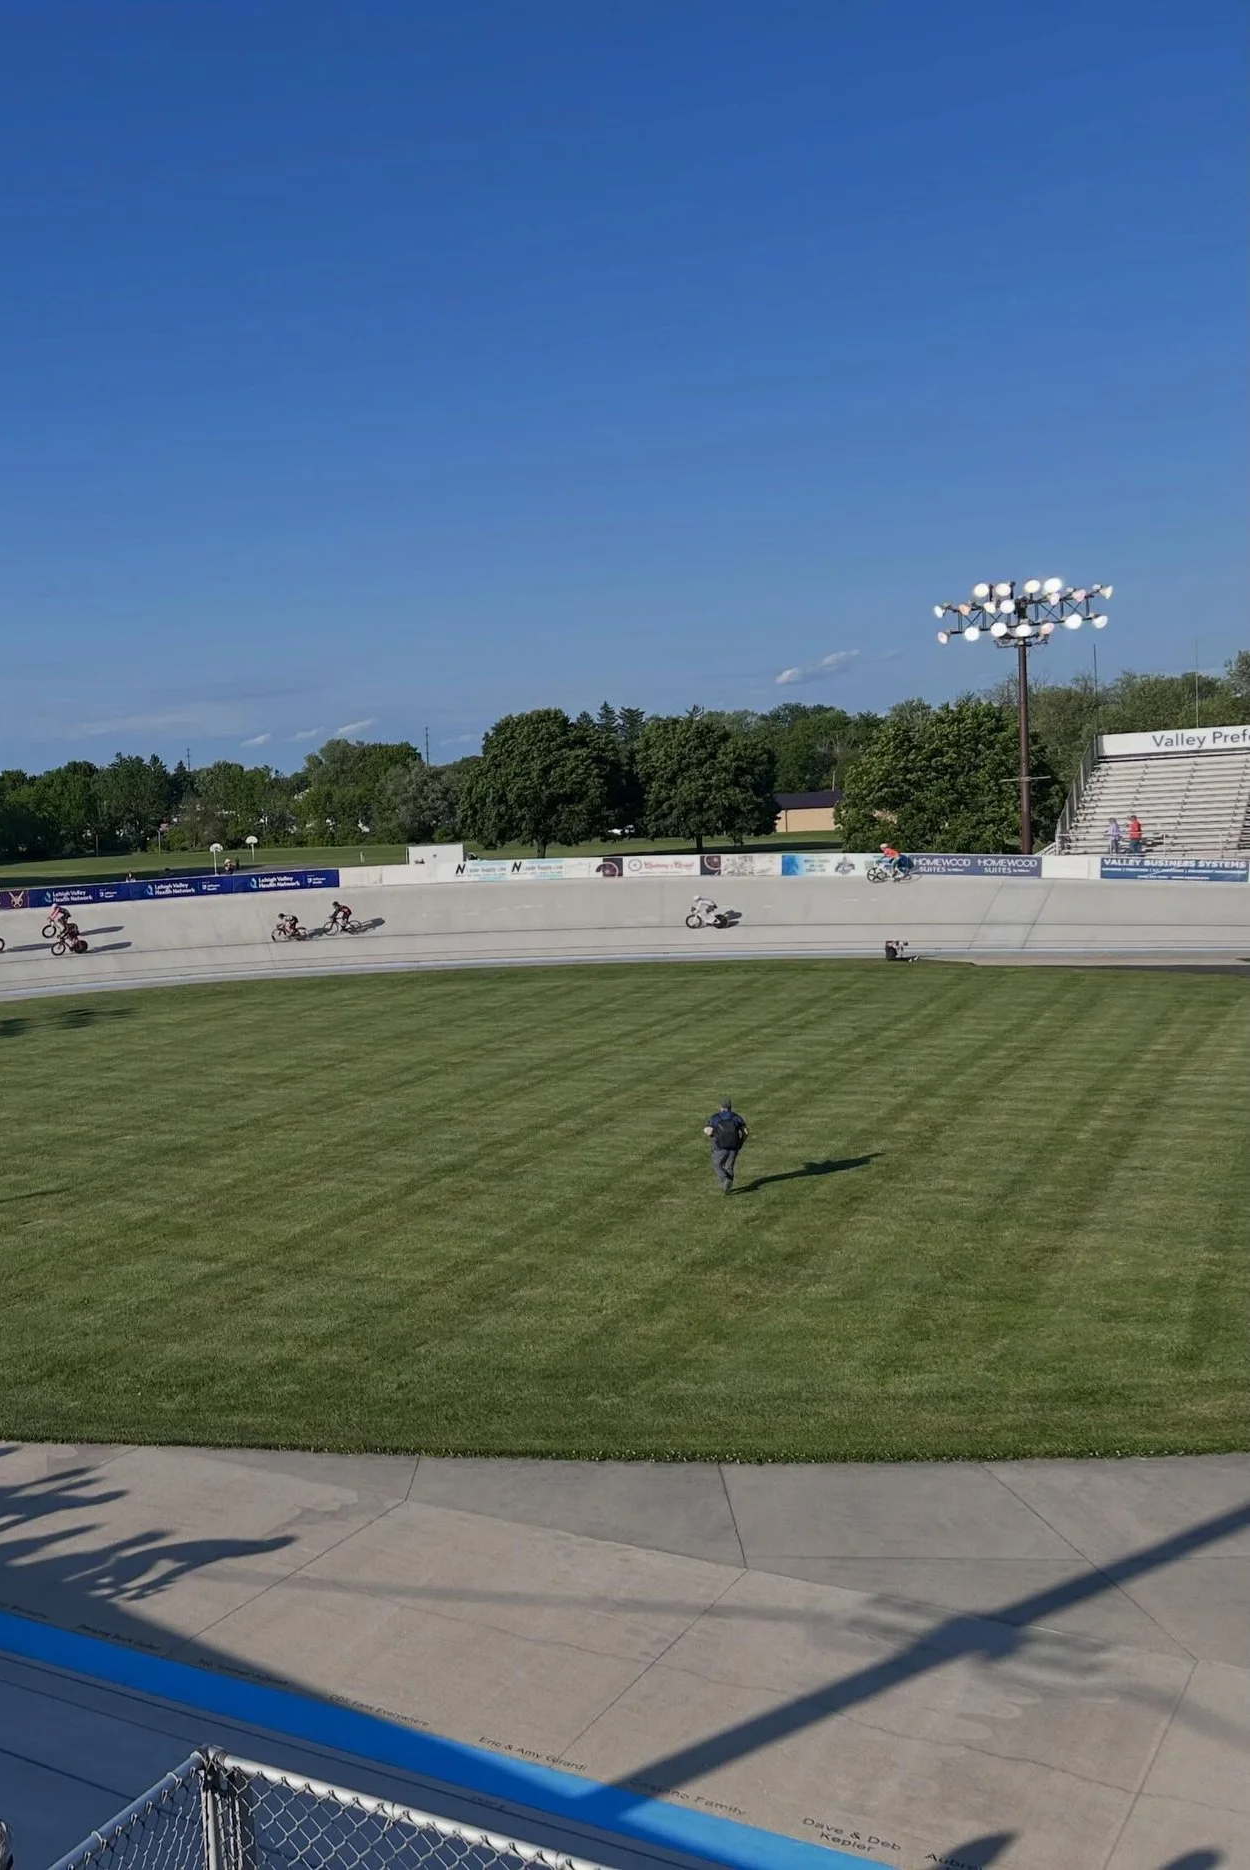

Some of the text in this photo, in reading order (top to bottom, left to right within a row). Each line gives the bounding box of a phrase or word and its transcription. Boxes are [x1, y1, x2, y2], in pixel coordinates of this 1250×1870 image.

[1152, 728, 1250, 749] Valley Pref
[913, 857, 971, 867] HOMEWOOD
[977, 858, 1038, 868] HOMEWOOD
[1103, 858, 1247, 869] VALLEY BUSINESS SYSTEMS
[259, 875, 293, 885] Lehigh Valley
[277, 880, 300, 888] Network
[154, 882, 189, 892] Lehigh Valley
[70, 889, 86, 897] Valley
[71, 894, 93, 902] Network
[375, 1707, 430, 1727] Everywhere
[479, 1736, 502, 1748] Eric
[516, 1748, 541, 1759] Amy
[546, 1754, 588, 1771] Girardi
[694, 1795, 746, 1816] Family
[802, 1817, 901, 1851] Dave & Deb
[820, 1832, 873, 1852] Kepler
